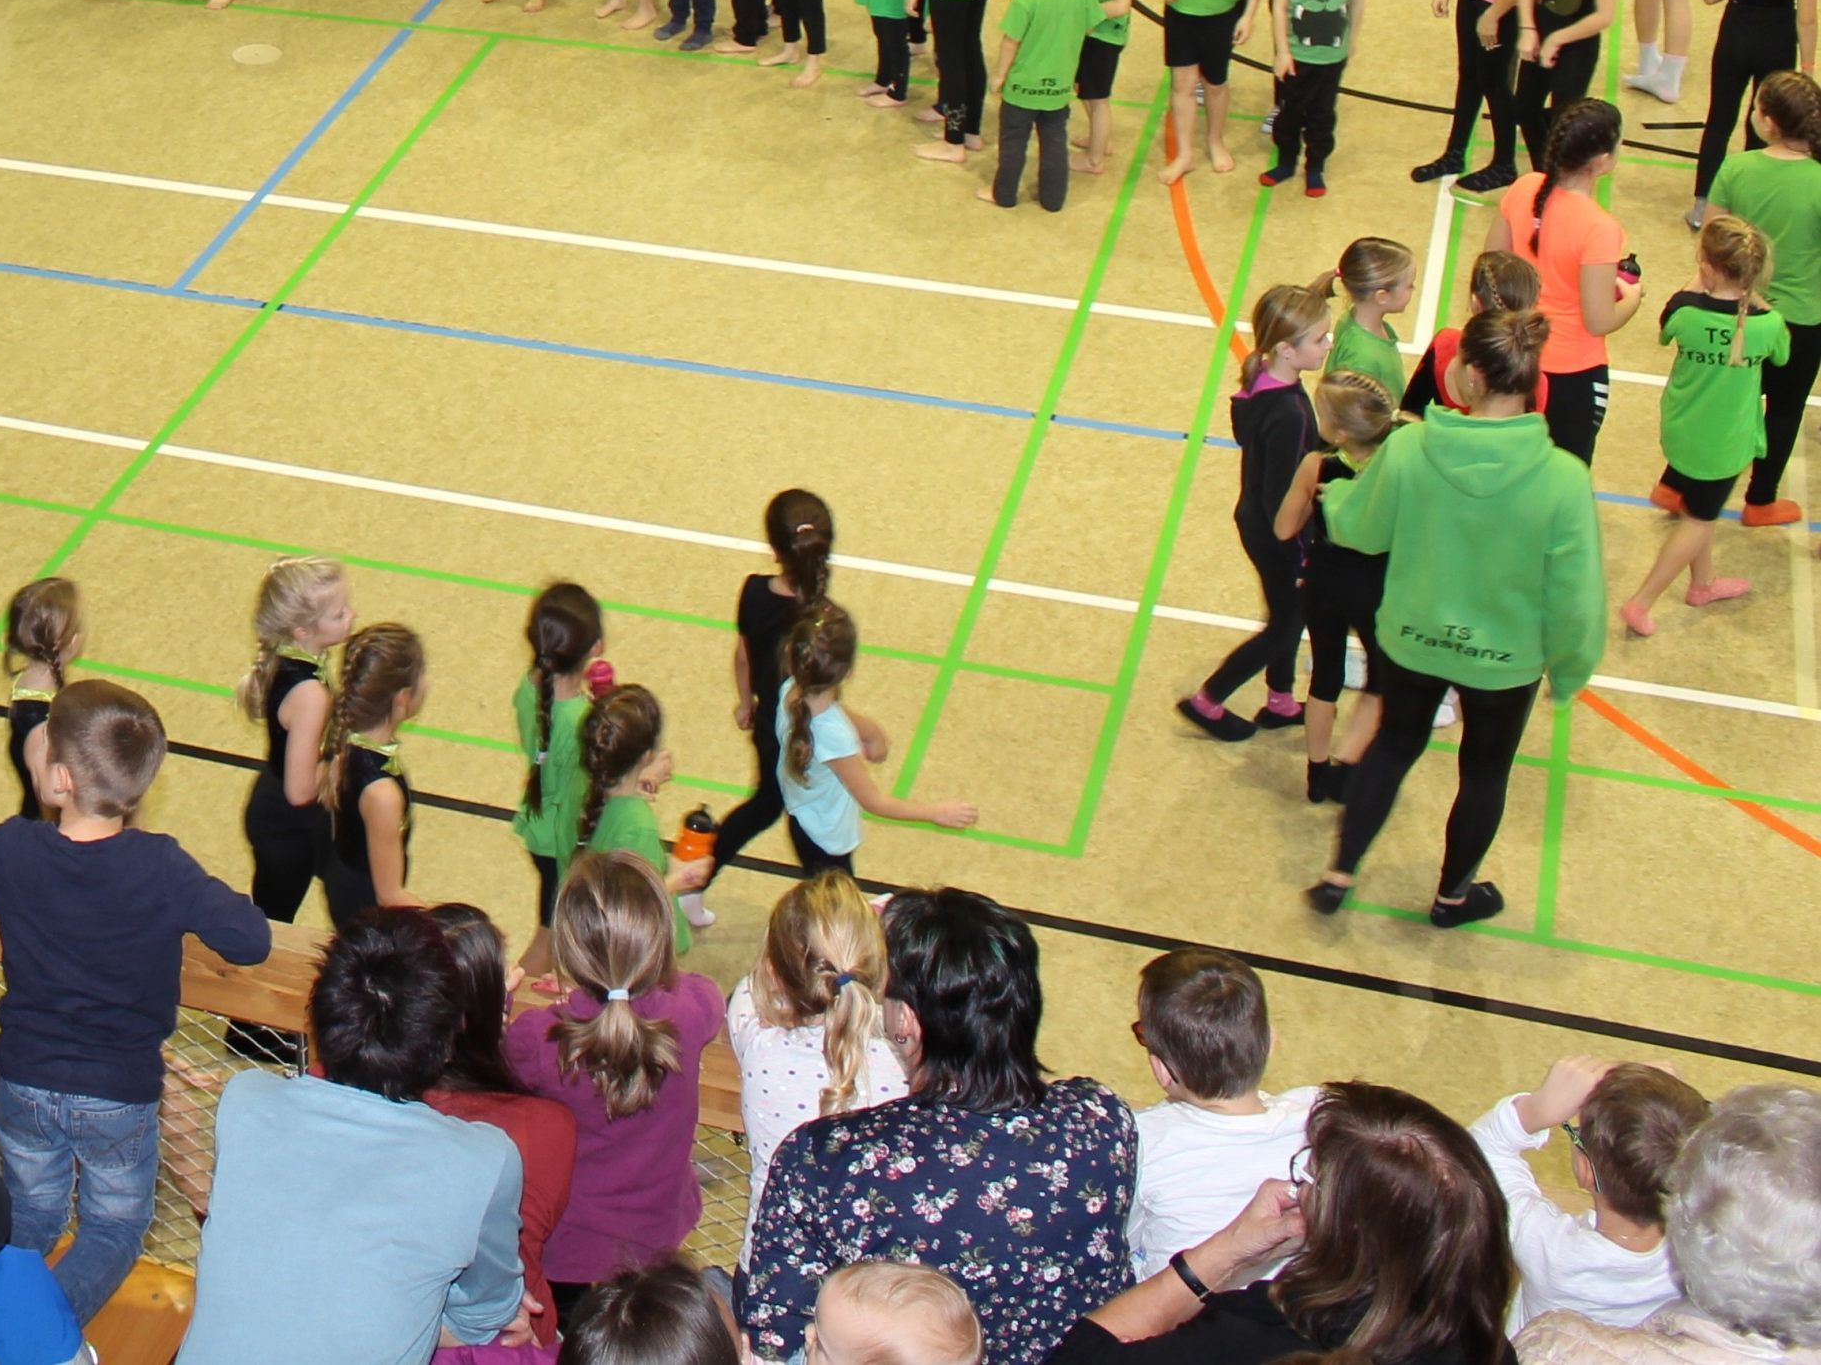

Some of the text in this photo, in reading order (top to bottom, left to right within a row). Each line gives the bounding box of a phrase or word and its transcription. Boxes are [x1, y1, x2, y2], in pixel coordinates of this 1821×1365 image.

[1041, 78, 1057, 87] TS
[1704, 327, 1732, 346] TS
[1677, 345, 1765, 368] Frastnz
[1443, 624, 1475, 641] TS
[1399, 625, 1514, 663] Frastanz
